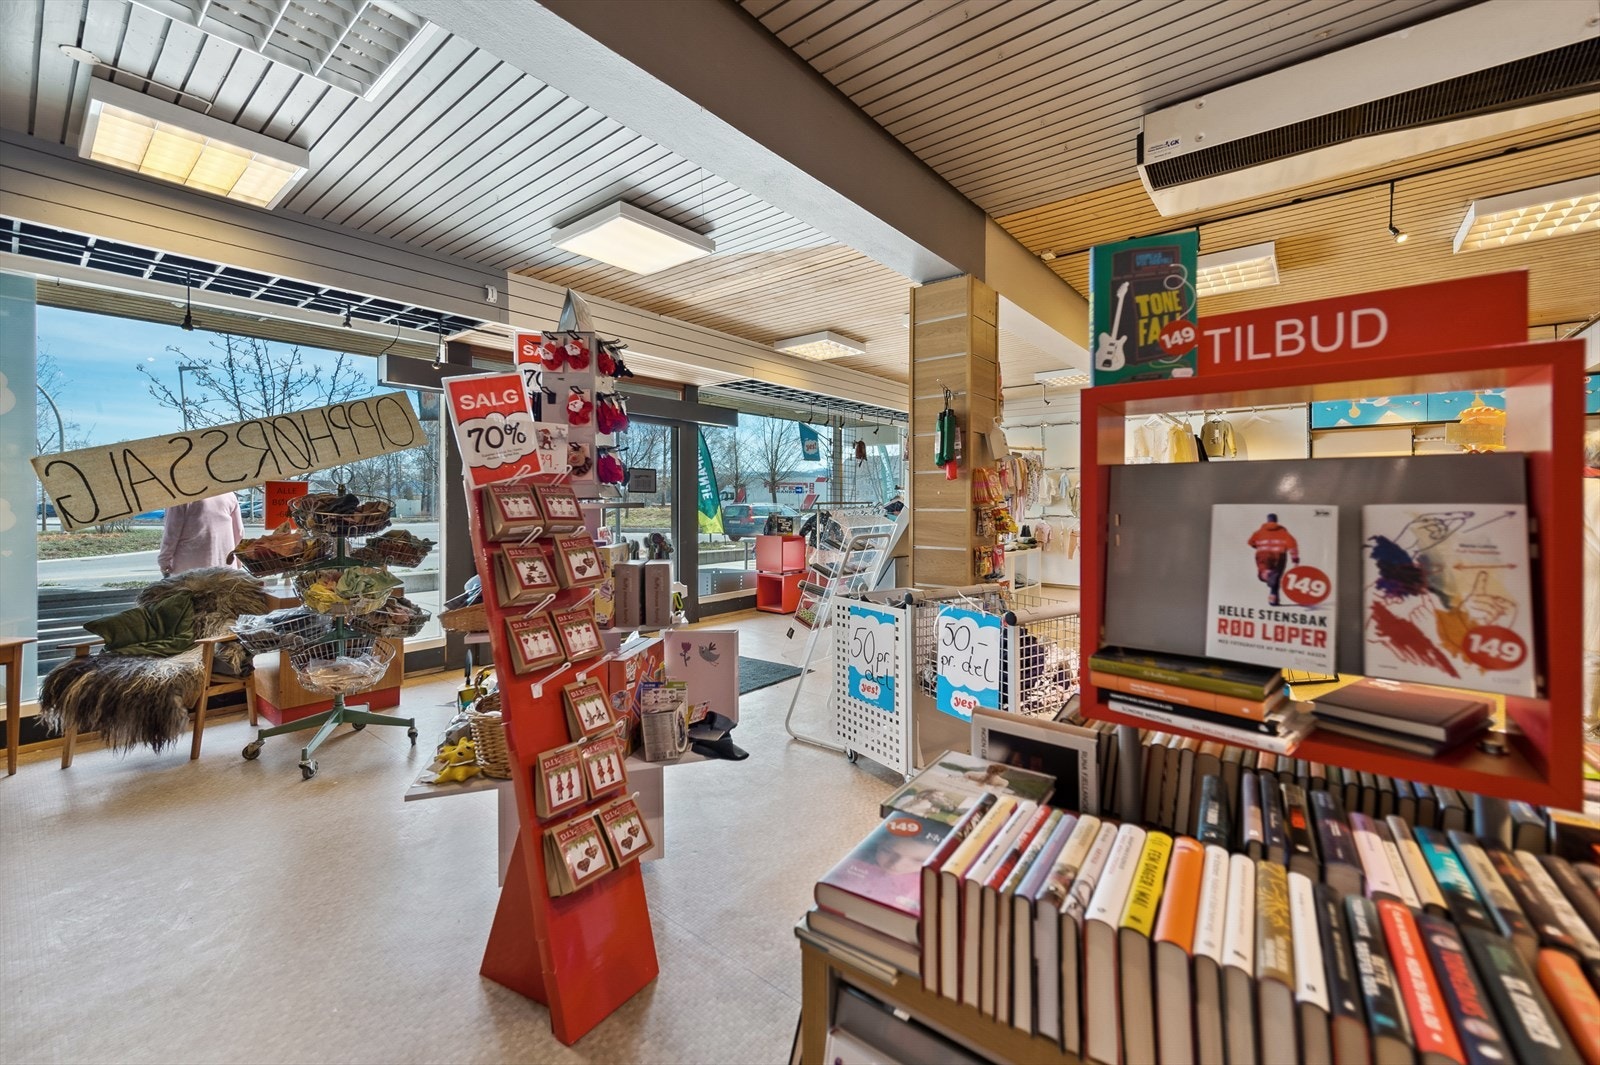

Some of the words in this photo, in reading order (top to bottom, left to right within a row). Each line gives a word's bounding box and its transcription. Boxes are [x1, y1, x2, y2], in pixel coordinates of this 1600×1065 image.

[1135, 290, 1182, 317] TONE
[1139, 313, 1181, 347] FA
[1161, 326, 1195, 349] 149
[1203, 308, 1389, 364] TILBUD
[523, 344, 542, 357] SA
[459, 388, 520, 410] SALG
[467, 422, 527, 453] 70%
[1286, 573, 1327, 598] 149
[1218, 605, 1254, 619] HELLE
[1259, 609, 1327, 628] STENSBAK
[942, 622, 988, 655] 50,-
[1217, 618, 1255, 639] RØD
[1262, 623, 1327, 648] LØPER
[851, 627, 875, 664] 50
[876, 651, 890, 672] pr.
[1468, 633, 1522, 663] 149
[864, 664, 892, 690] del
[941, 655, 956, 675] pr.
[962, 654, 994, 683] del
[861, 683, 879, 696] yes!
[953, 697, 977, 710] yes!
[888, 821, 920, 834] 149
[1148, 849, 1162, 863] FEM
[1139, 863, 1158, 887] DAGER
